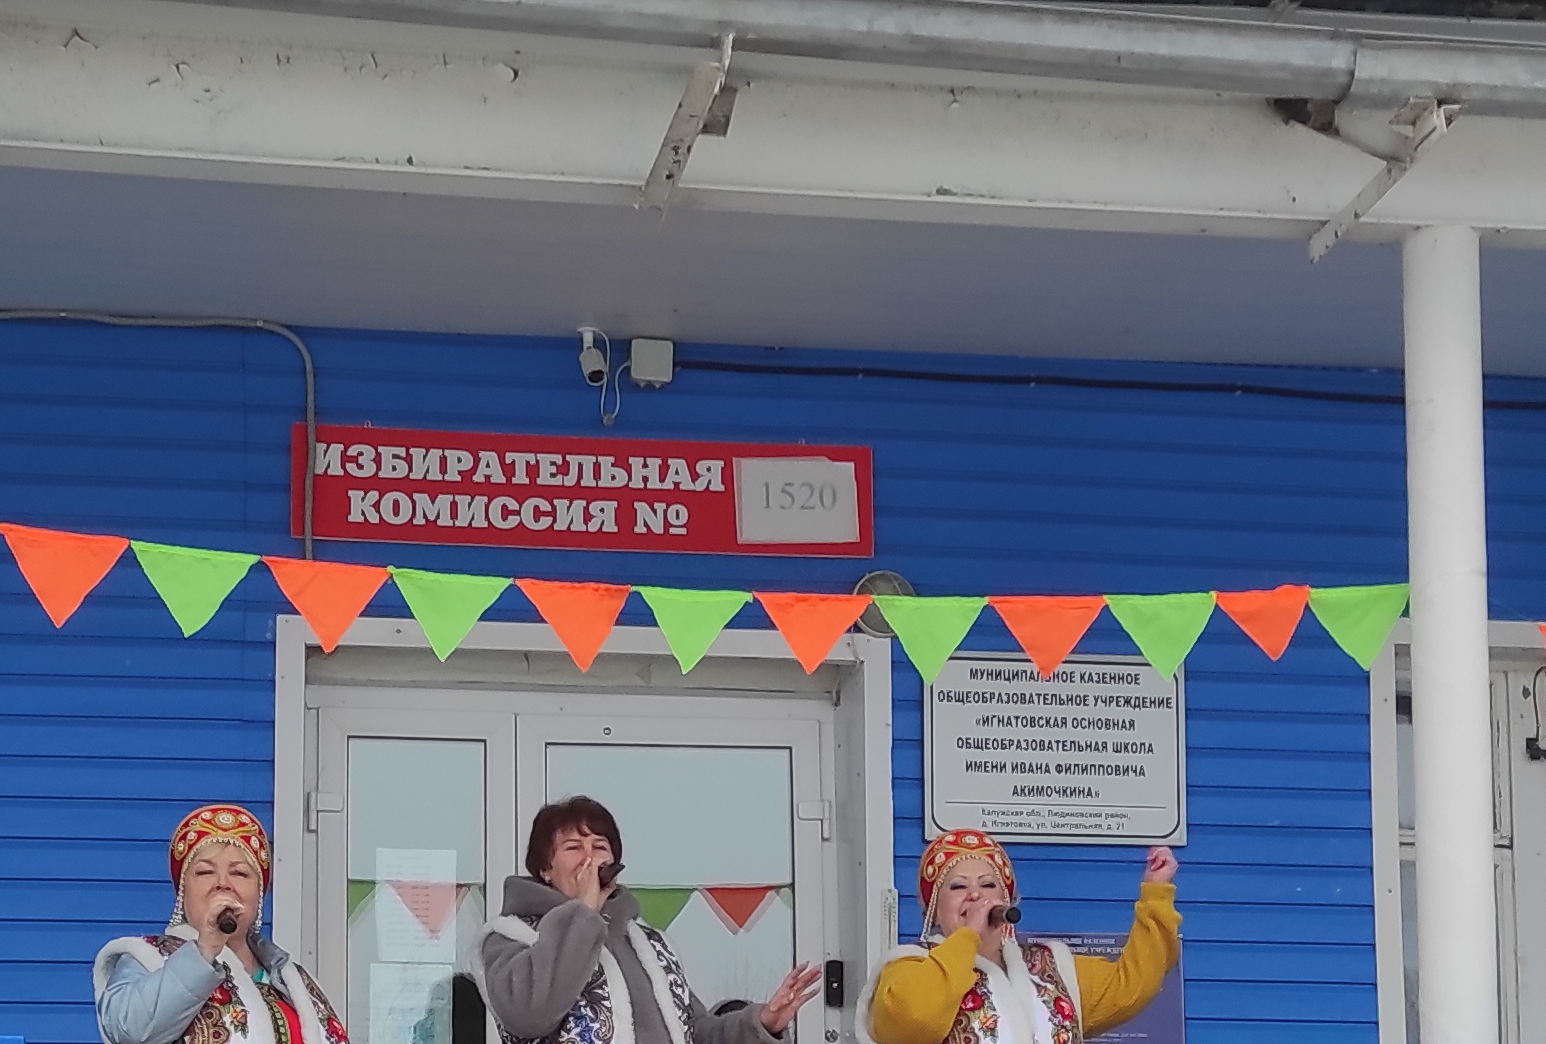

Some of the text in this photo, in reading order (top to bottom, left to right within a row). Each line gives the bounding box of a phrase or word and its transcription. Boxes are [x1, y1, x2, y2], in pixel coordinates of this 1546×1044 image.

[315, 443, 725, 492] ИЗБИРАТЕЛЬНАЯ
[761, 481, 838, 512] 1520
[347, 490, 689, 535] КОМИССИЯ №
[1079, 672, 1141, 686] КАЗЕННОЕ
[937, 690, 1173, 710] ОБЩЕОБРАЗОВАТЕЛЬНОЕ УЧРЕЖДЕНИЕ
[975, 714, 1135, 732] «ИГНАТОВСКАЯ ОСНОВНАЯ
[956, 736, 1155, 754] ОБЩЕОБРАЗОВАТЕЛЬНАЯ ШКОЛА
[965, 760, 1145, 777] ИМЕНИ ИВАНА ФИЛИППОВИЧА
